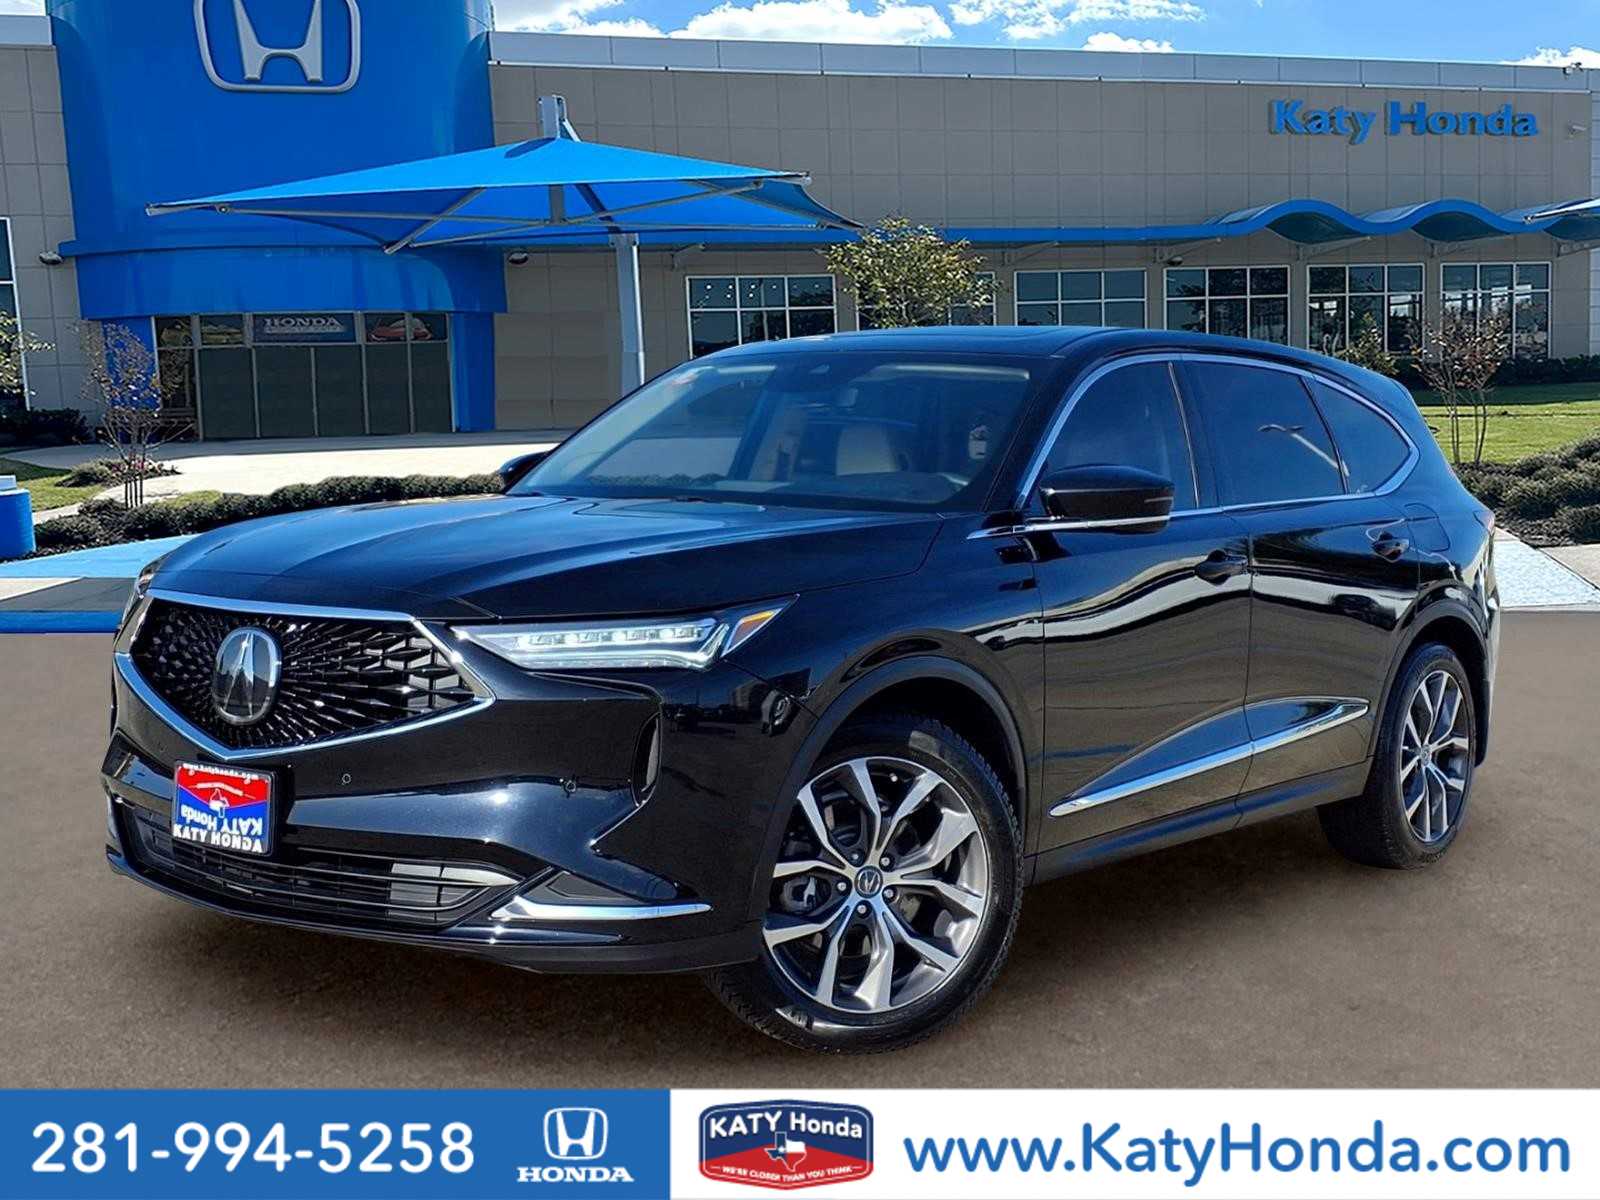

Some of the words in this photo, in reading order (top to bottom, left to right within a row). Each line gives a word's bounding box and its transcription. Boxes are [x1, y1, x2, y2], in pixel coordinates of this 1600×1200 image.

[1269, 100, 1376, 145] Katy
[1384, 101, 1539, 137] Honda
[264, 317, 343, 326] HONDA
[181, 805, 218, 830] Honda
[221, 818, 263, 836] KATY
[173, 824, 208, 842] KATY
[211, 832, 262, 853] HONDA
